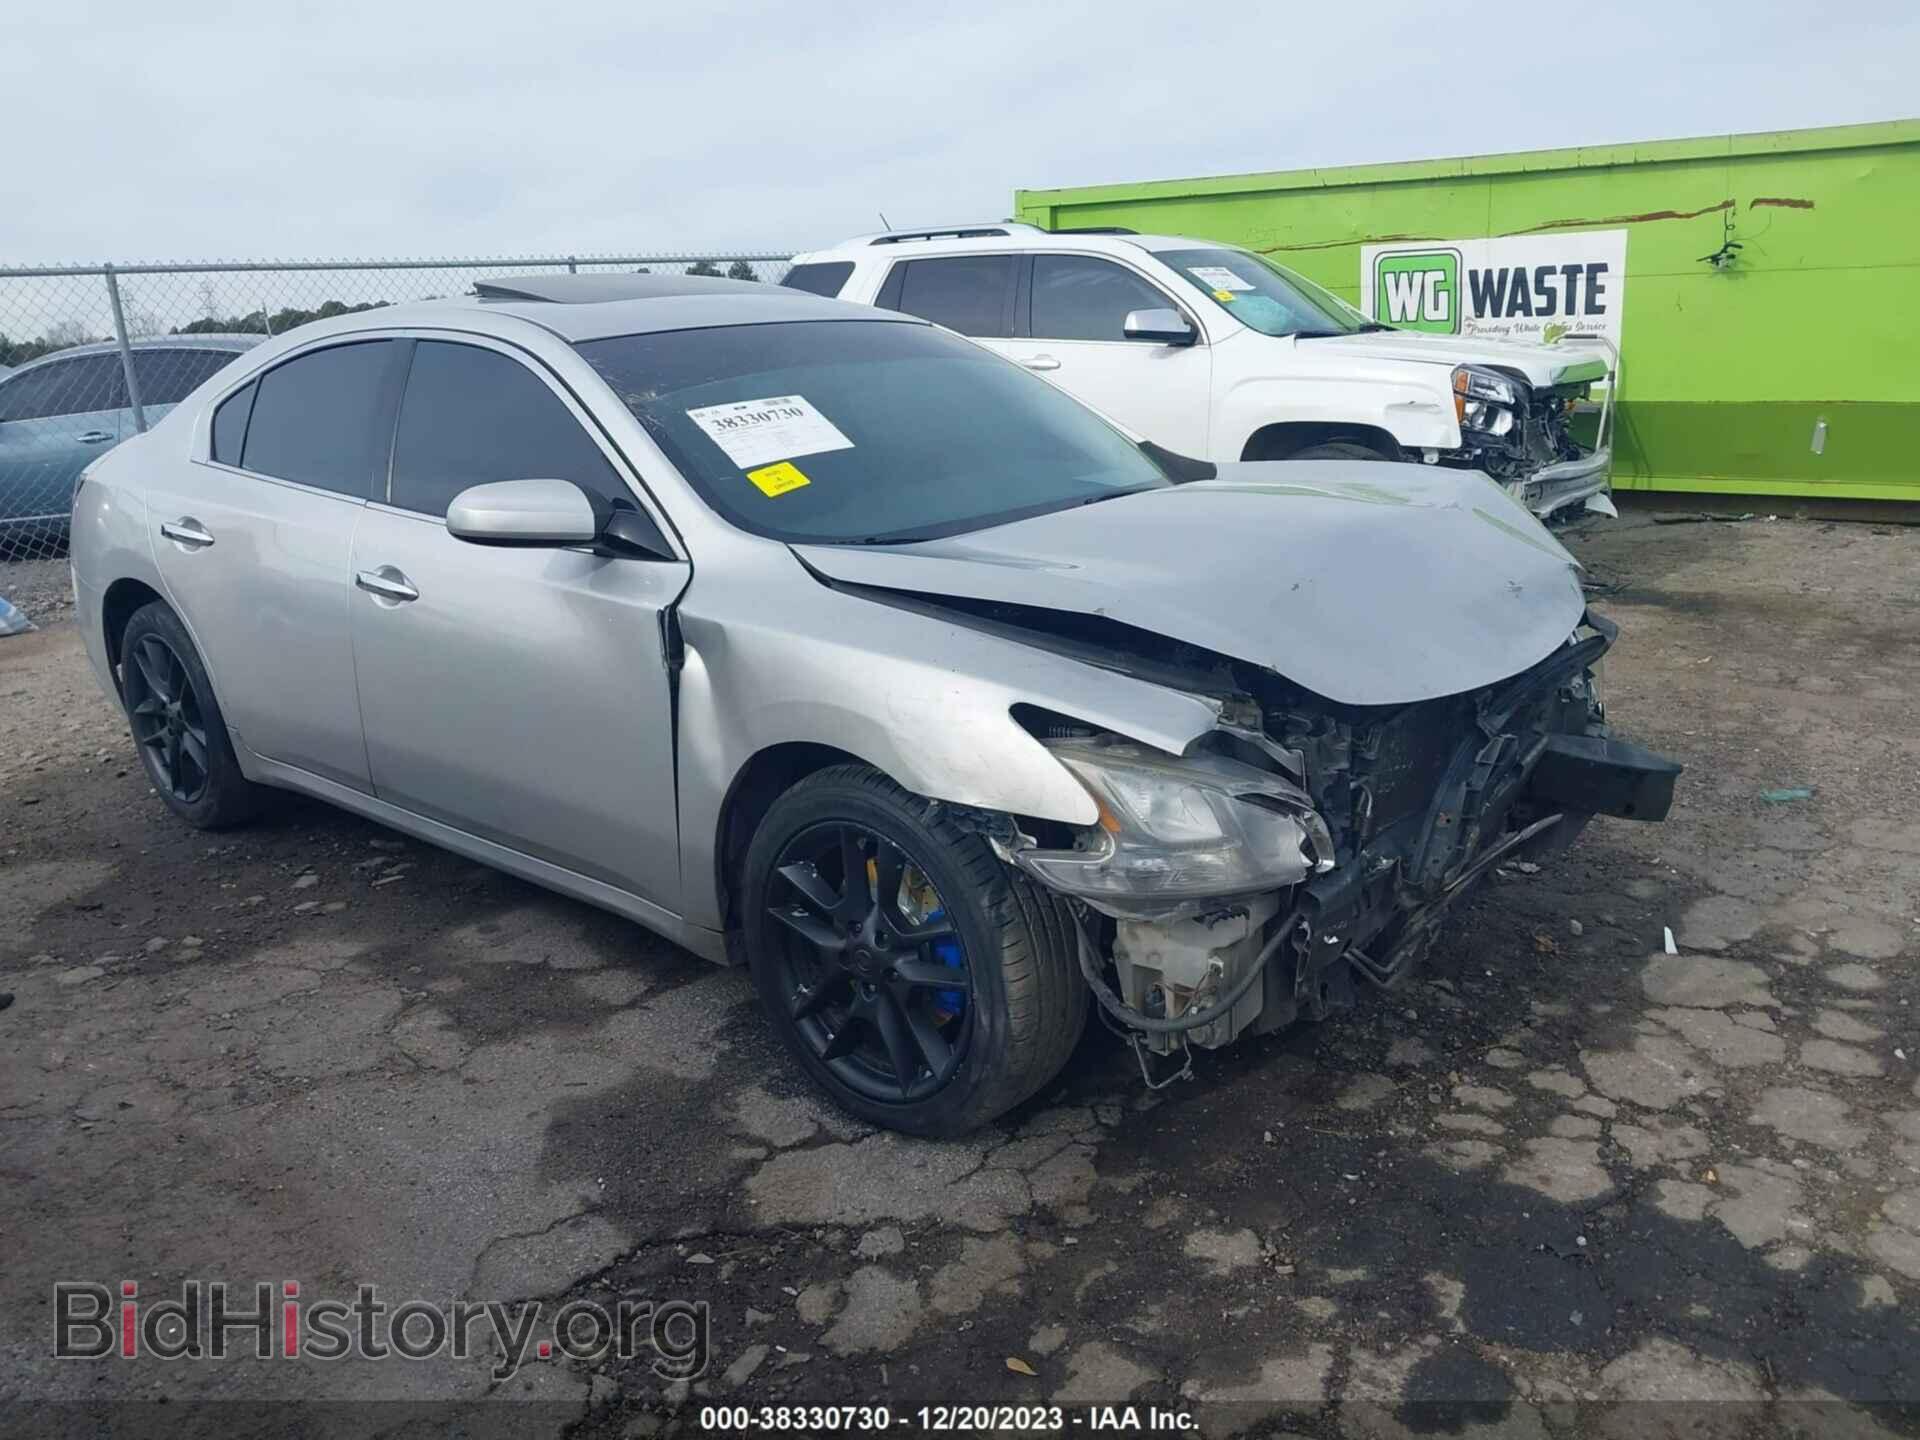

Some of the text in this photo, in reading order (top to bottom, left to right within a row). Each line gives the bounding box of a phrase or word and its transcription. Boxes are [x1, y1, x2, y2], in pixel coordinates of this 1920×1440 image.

[1383, 262, 1609, 323] WG WASTE
[711, 407, 804, 431] 38330730
